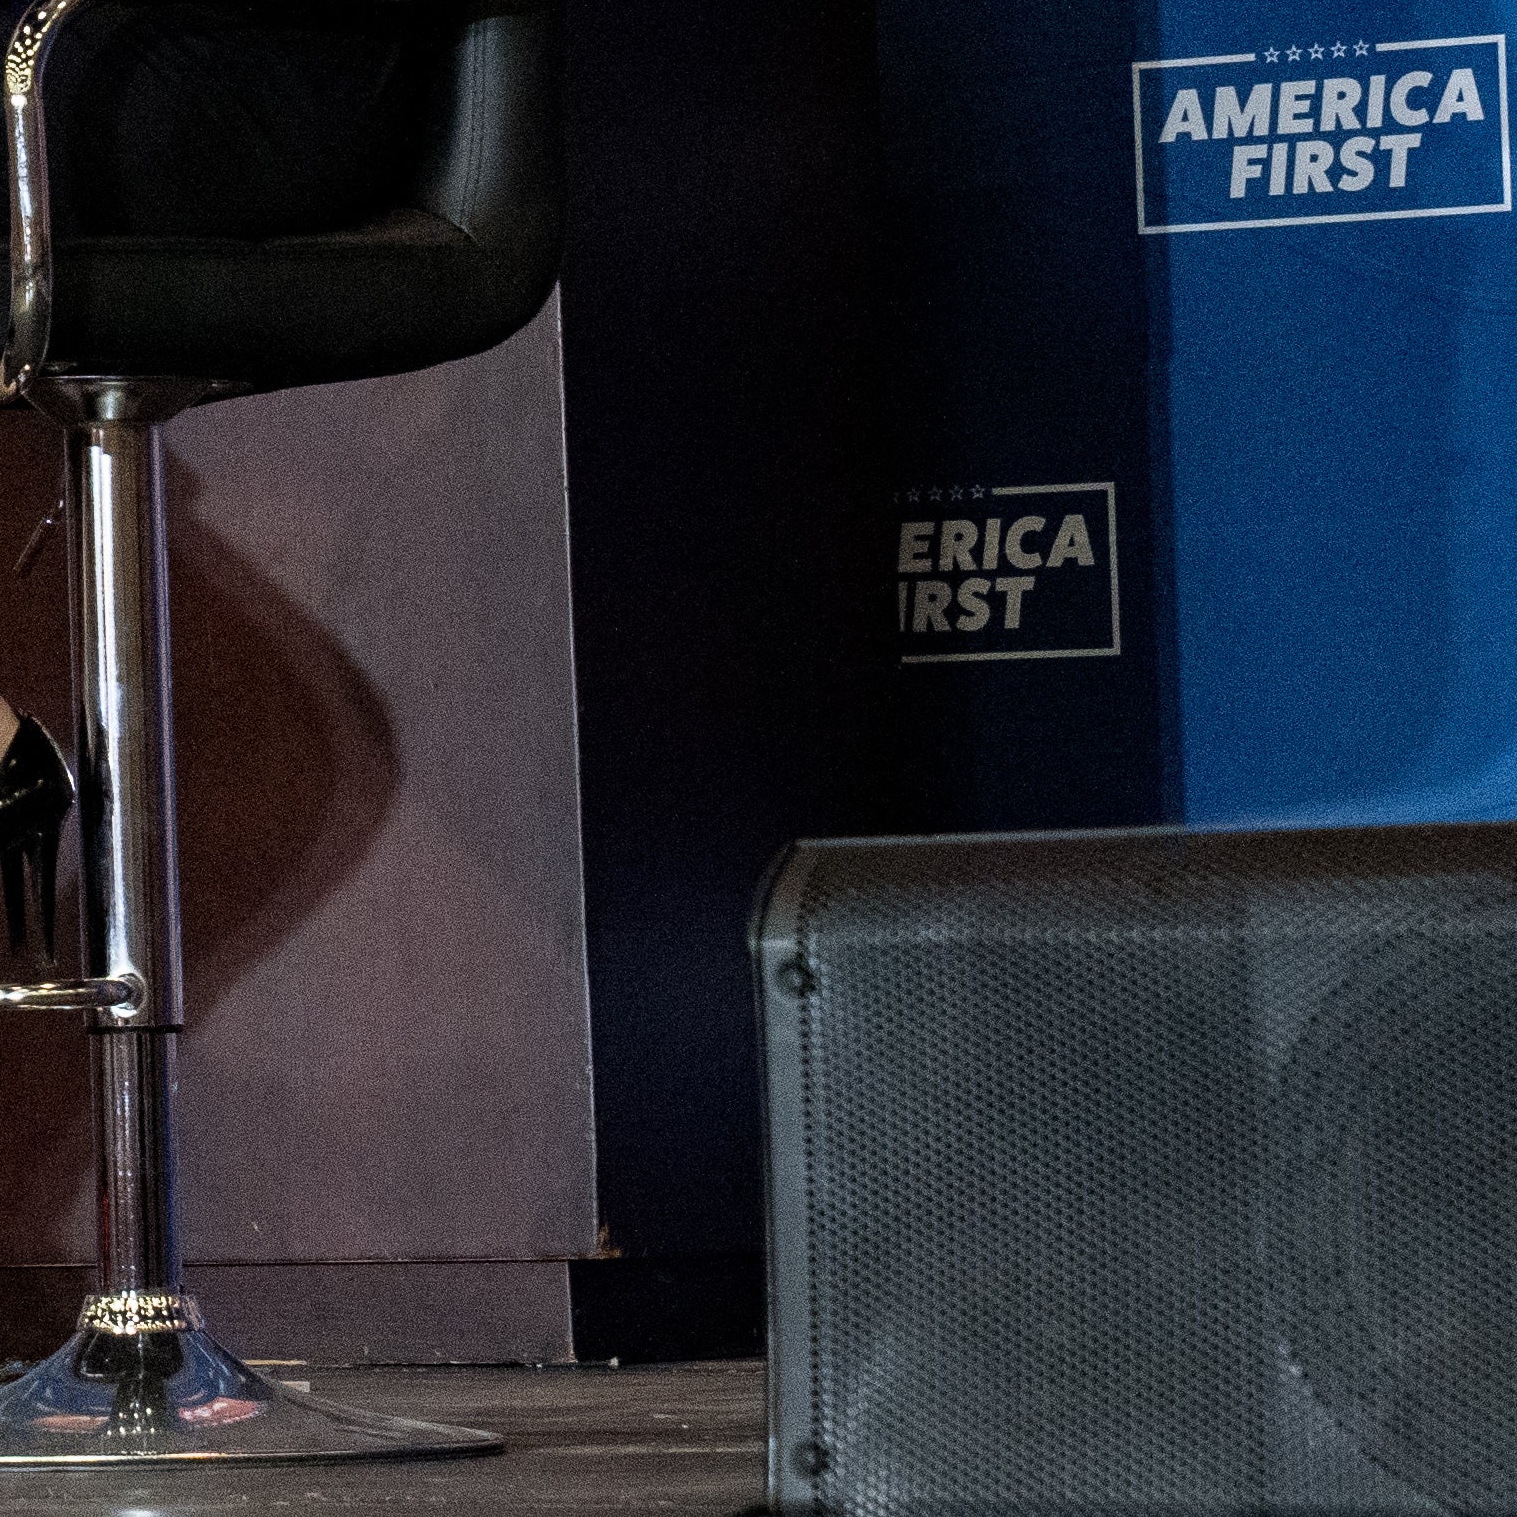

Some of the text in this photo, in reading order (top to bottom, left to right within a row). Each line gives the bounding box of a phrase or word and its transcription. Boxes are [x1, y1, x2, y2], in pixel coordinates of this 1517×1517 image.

[1160, 67, 1485, 143] AMERICA
[1230, 133, 1422, 199] FIRST
[897, 514, 1095, 573] ERICA
